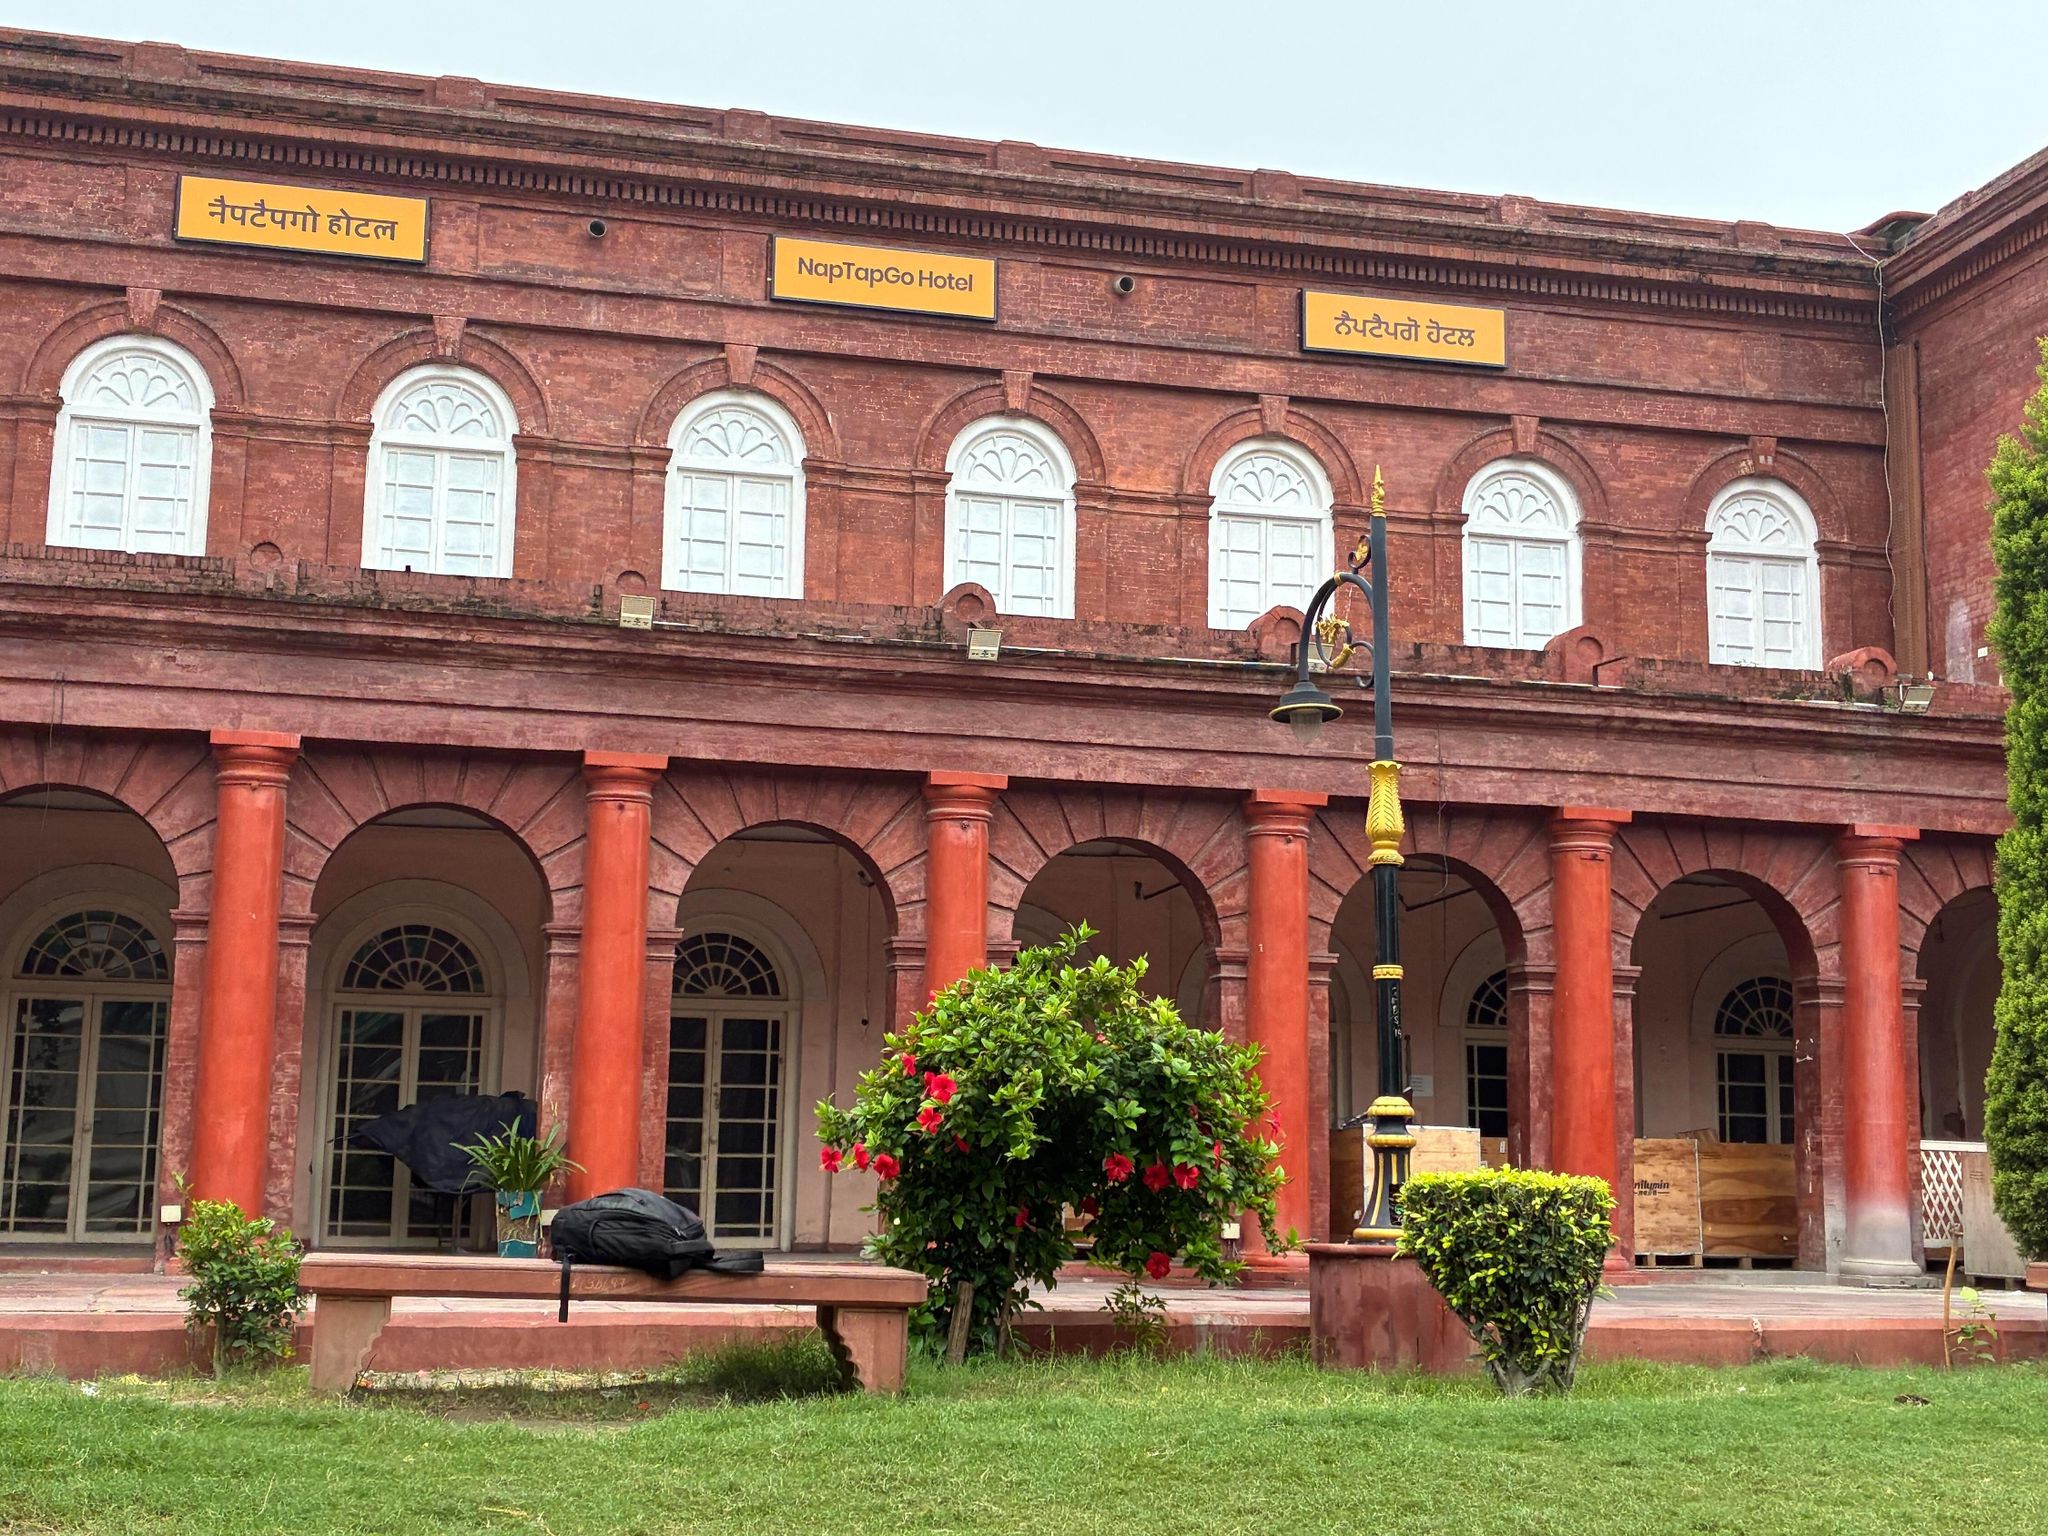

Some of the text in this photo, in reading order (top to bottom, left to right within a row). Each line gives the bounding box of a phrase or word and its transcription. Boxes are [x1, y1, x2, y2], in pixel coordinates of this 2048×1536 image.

[208, 195, 398, 241] नैपटैपगो होटल
[798, 257, 973, 292] NapTapGo Hotel
[1334, 310, 1475, 347] ਨੈਪਟੈਪਗੋ ਹੋਟਲ
